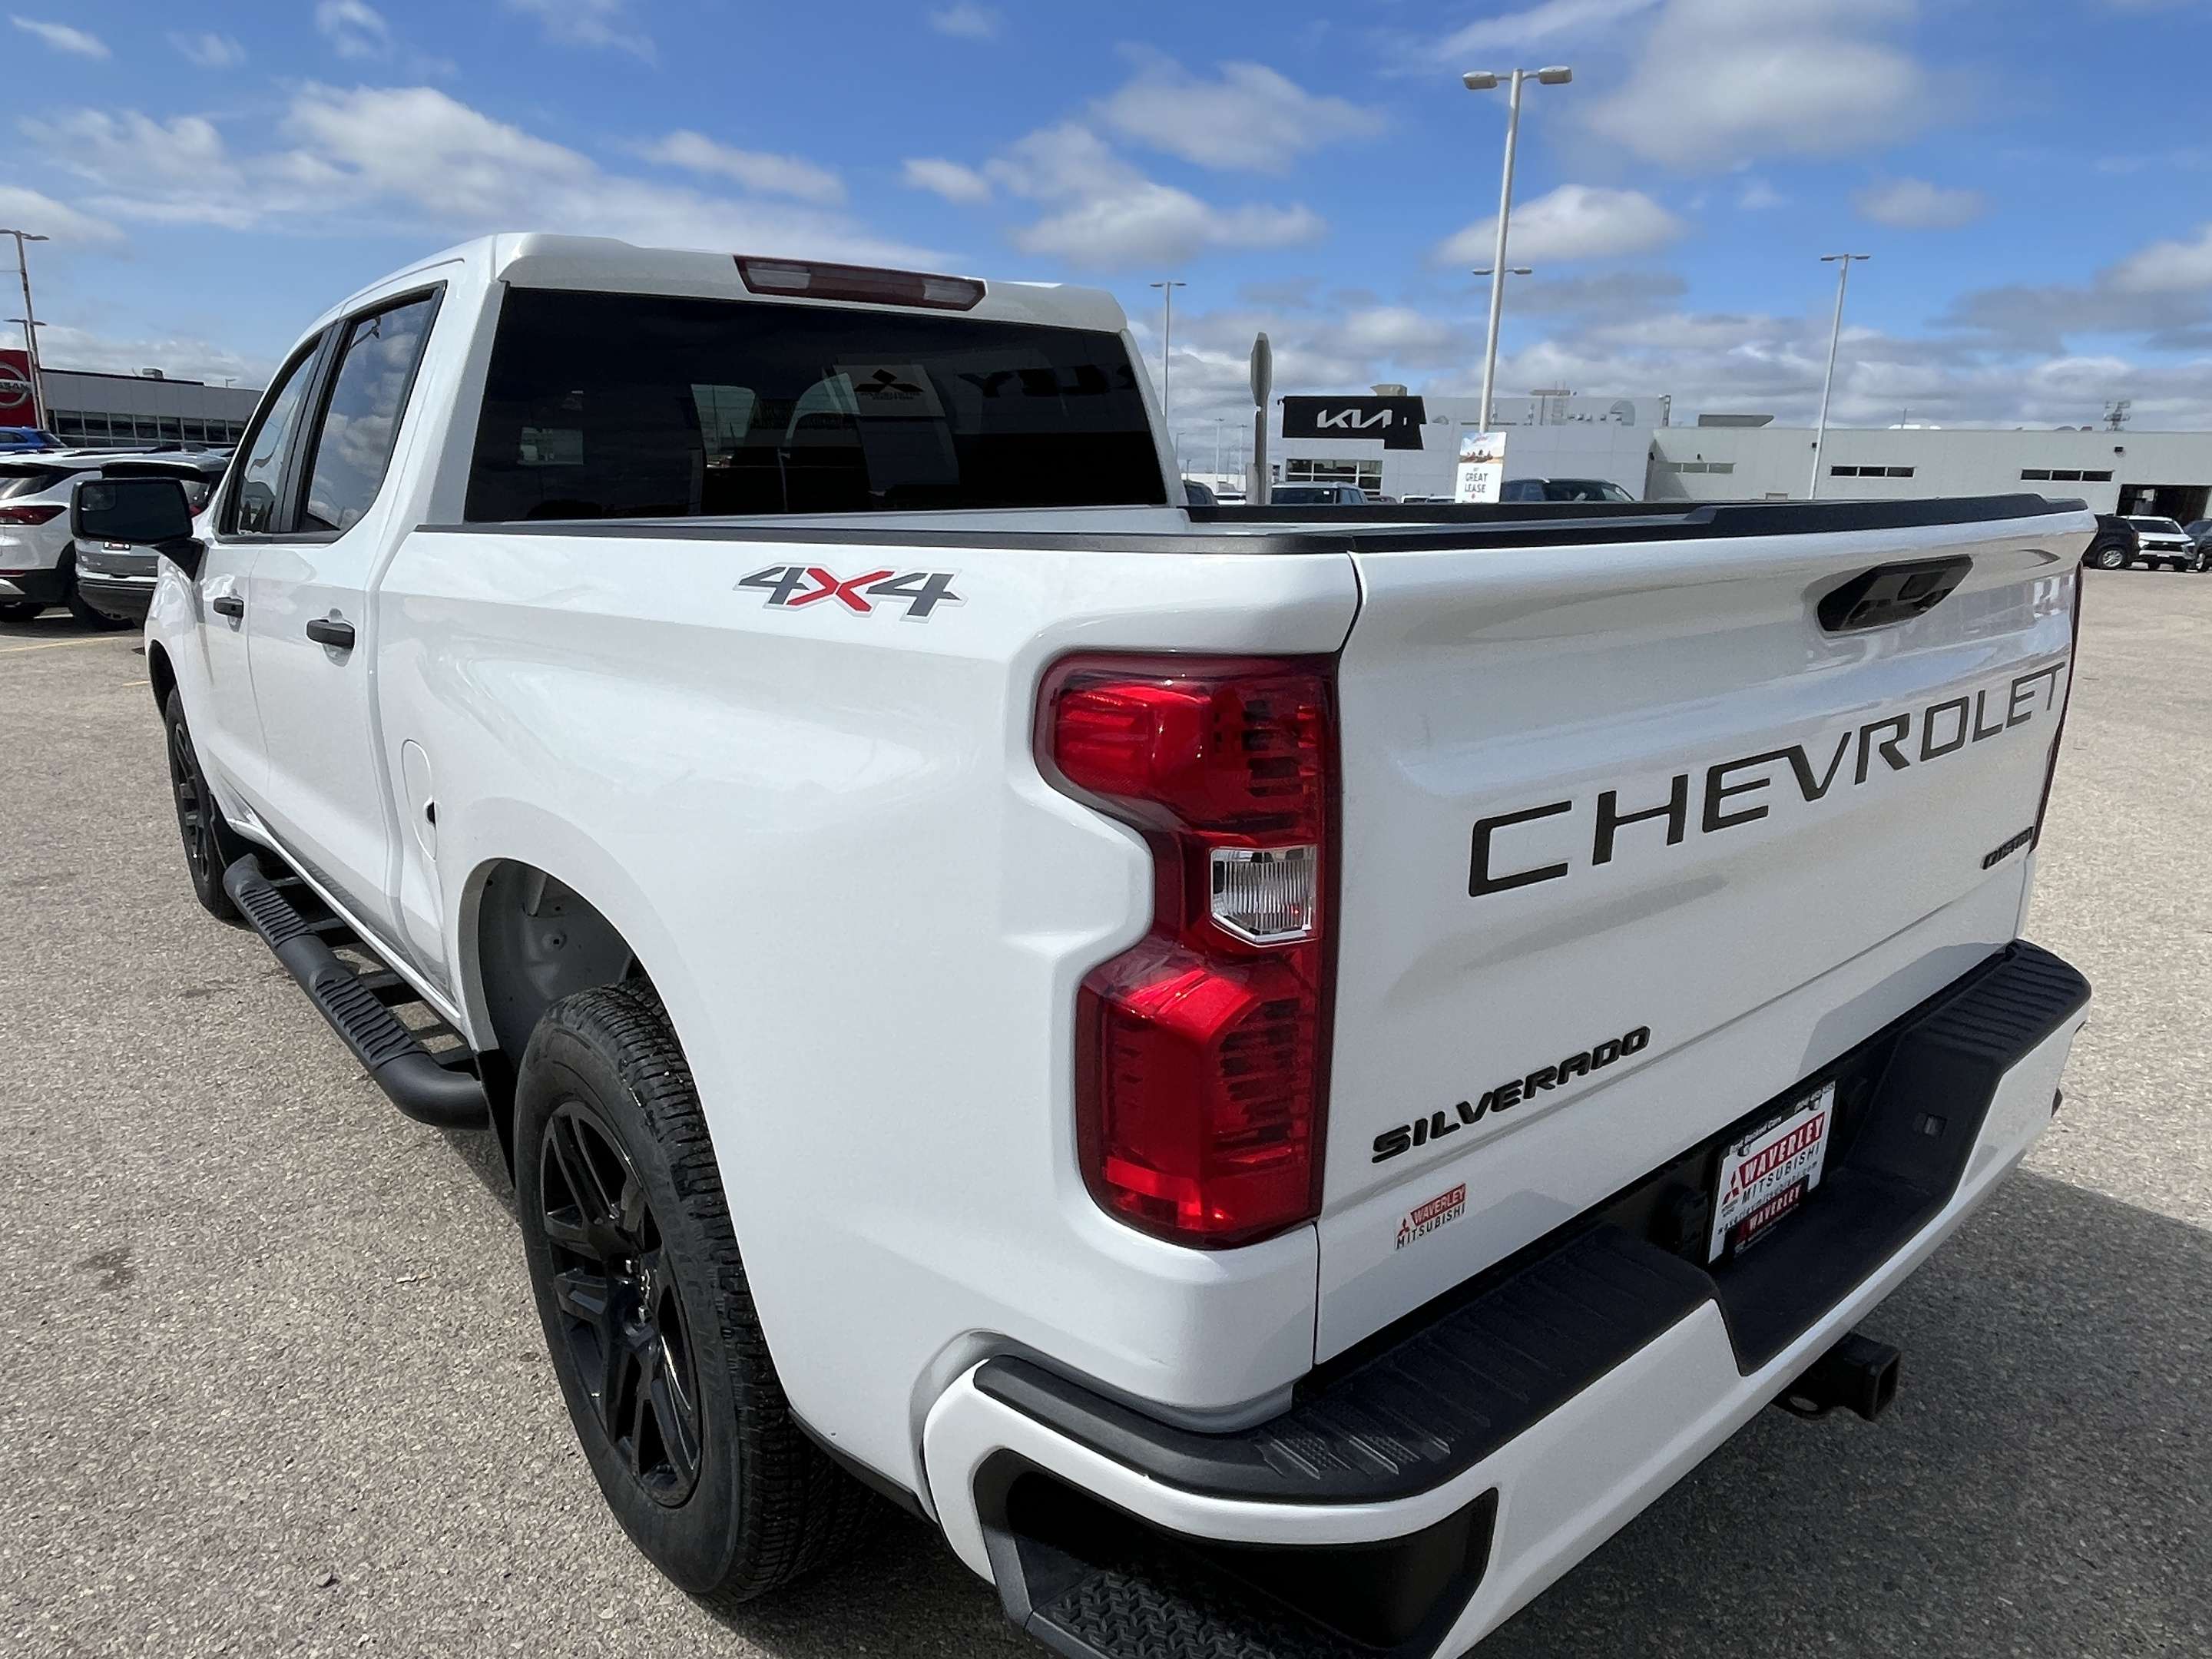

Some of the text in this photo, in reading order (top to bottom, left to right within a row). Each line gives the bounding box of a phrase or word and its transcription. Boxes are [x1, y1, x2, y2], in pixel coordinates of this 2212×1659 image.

[1316, 409, 1392, 428] KIA
[1465, 473, 1488, 482] GREAT
[1465, 483, 1486, 492] LEASE
[1469, 661, 2065, 897] CHEVROLET
[1372, 1026, 1651, 1163] SILVERADO
[1745, 1116, 1823, 1183] WAVERLEY
[1742, 1146, 1820, 1204] MITSUBISHI
[1396, 1203, 1465, 1250] MITSUBISHI
[1413, 1185, 1465, 1224] WAVERLEY
[1750, 1185, 1801, 1231] WAVERLEY
